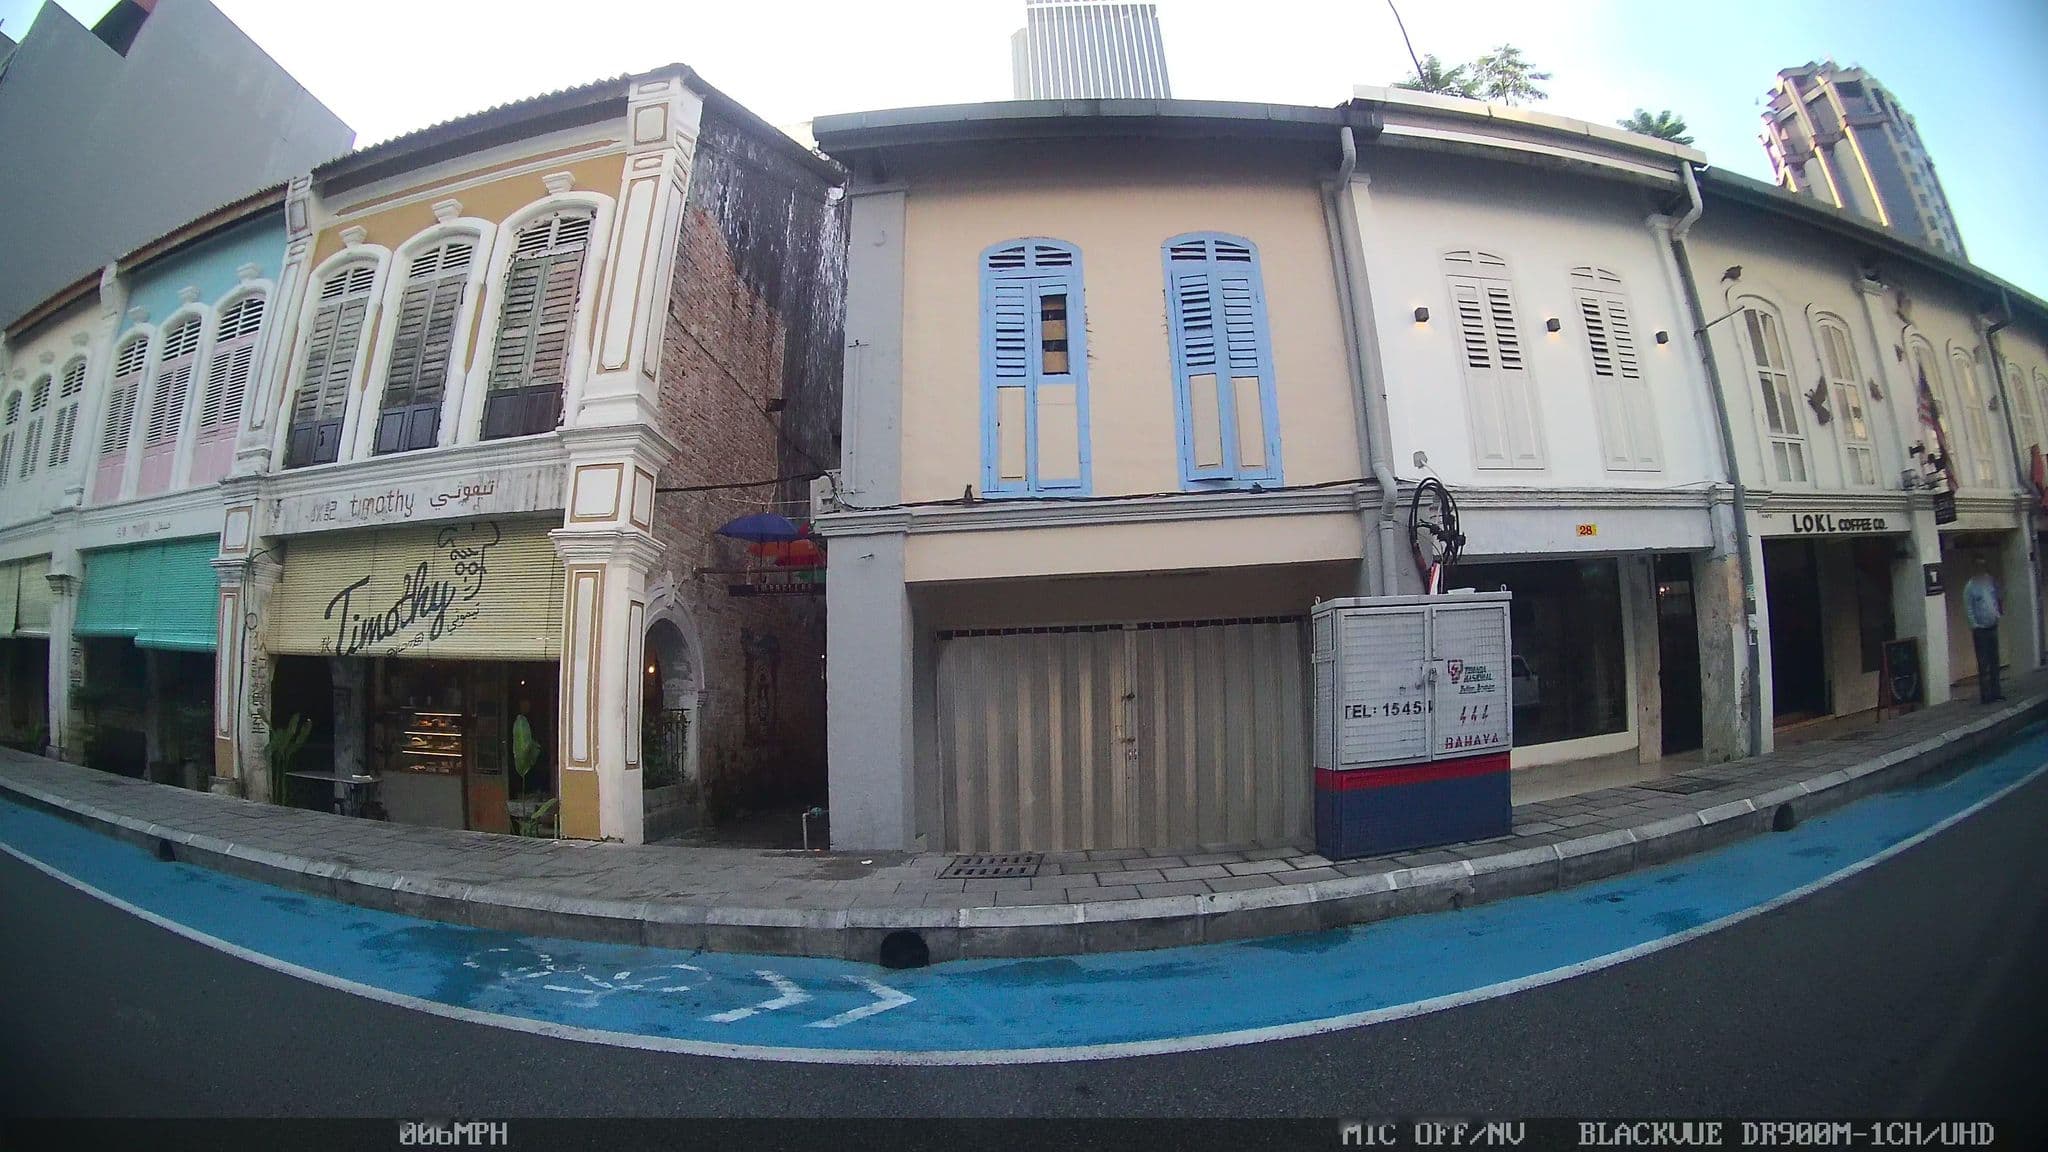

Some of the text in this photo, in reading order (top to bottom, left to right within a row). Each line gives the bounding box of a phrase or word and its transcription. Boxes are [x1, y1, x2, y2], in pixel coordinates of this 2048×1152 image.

[350, 488, 415, 518] timothy
[1579, 525, 1593, 536] 28
[1792, 514, 1889, 533] LOKL COFFEE CO.
[324, 561, 456, 656] Timothy
[1445, 733, 1499, 749] BAHAYA
